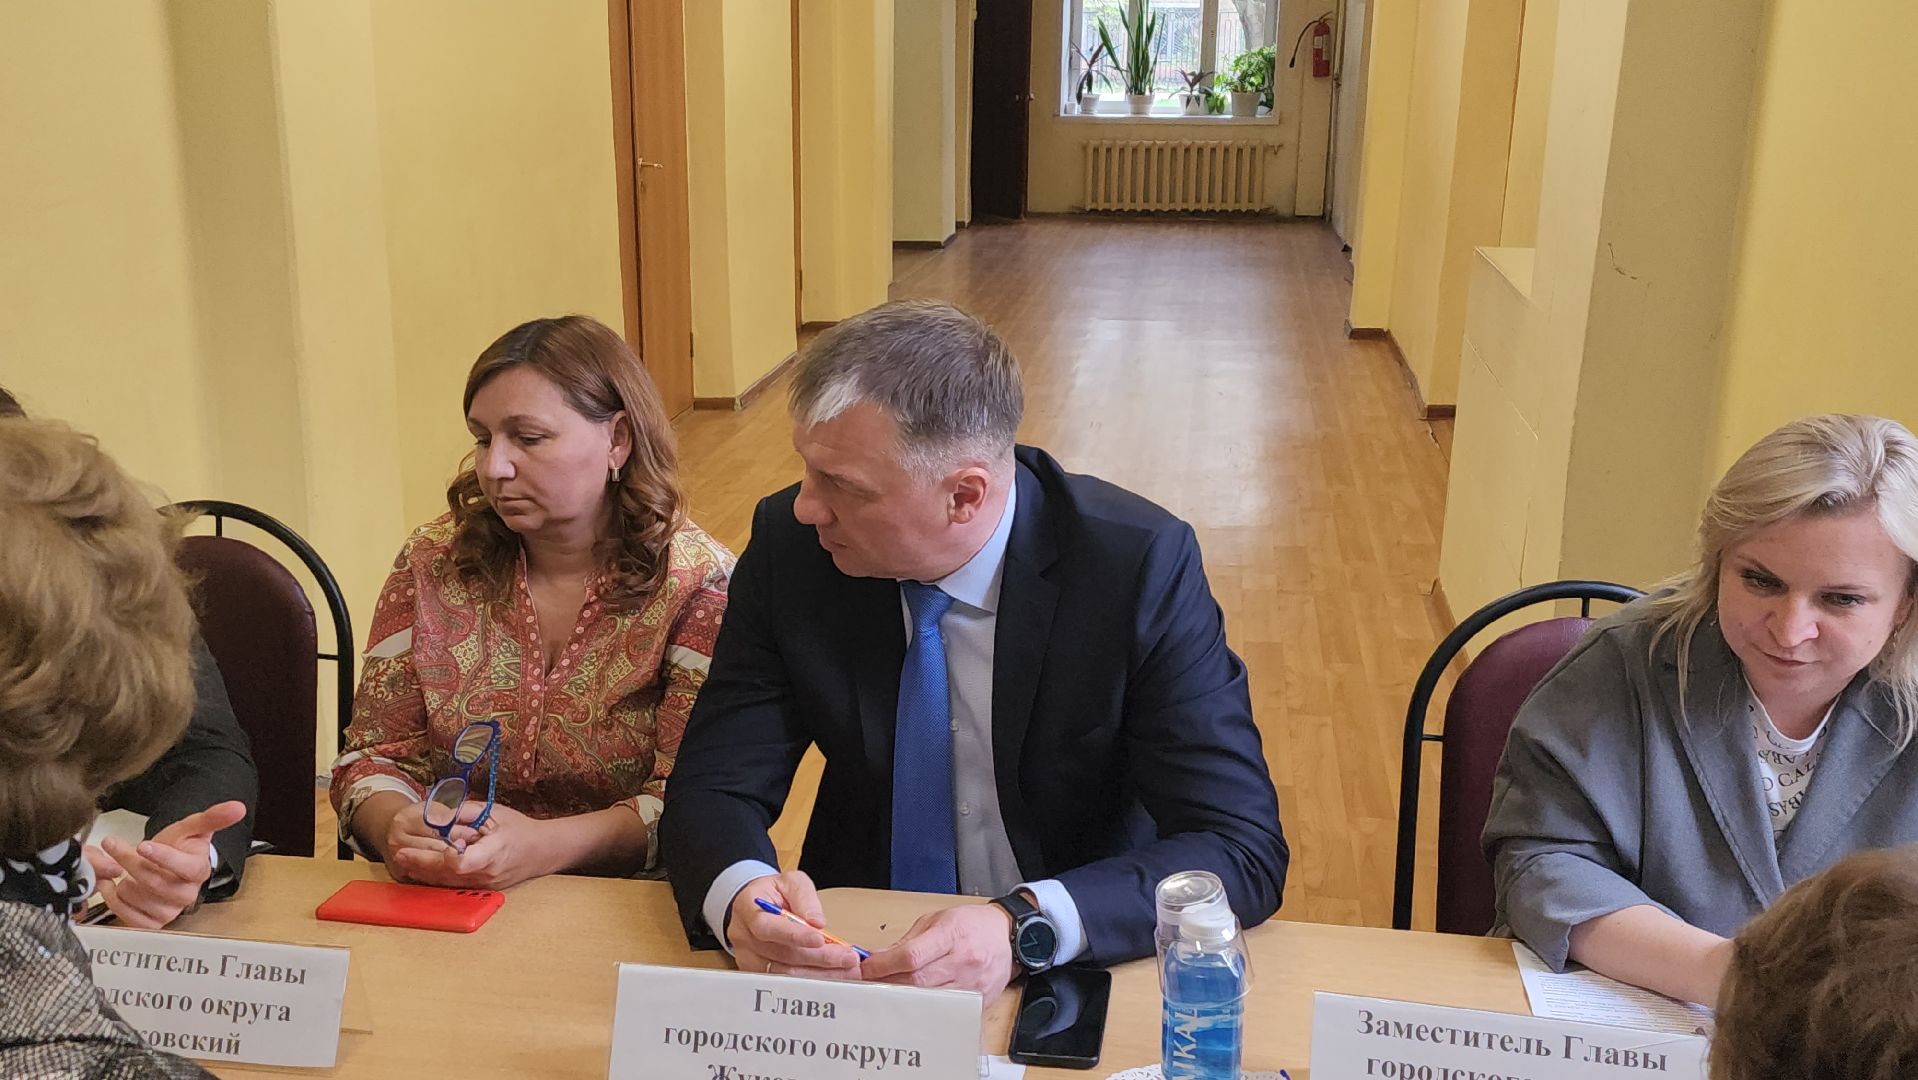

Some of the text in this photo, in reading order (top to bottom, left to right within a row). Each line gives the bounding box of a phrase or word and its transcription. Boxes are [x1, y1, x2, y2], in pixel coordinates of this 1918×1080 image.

[218, 954, 307, 985] Главы
[201, 995, 291, 1025] округа
[752, 989, 837, 1019] Глава
[663, 1026, 922, 1070] городского округа
[1356, 1009, 1669, 1072] Заместитель Главы
